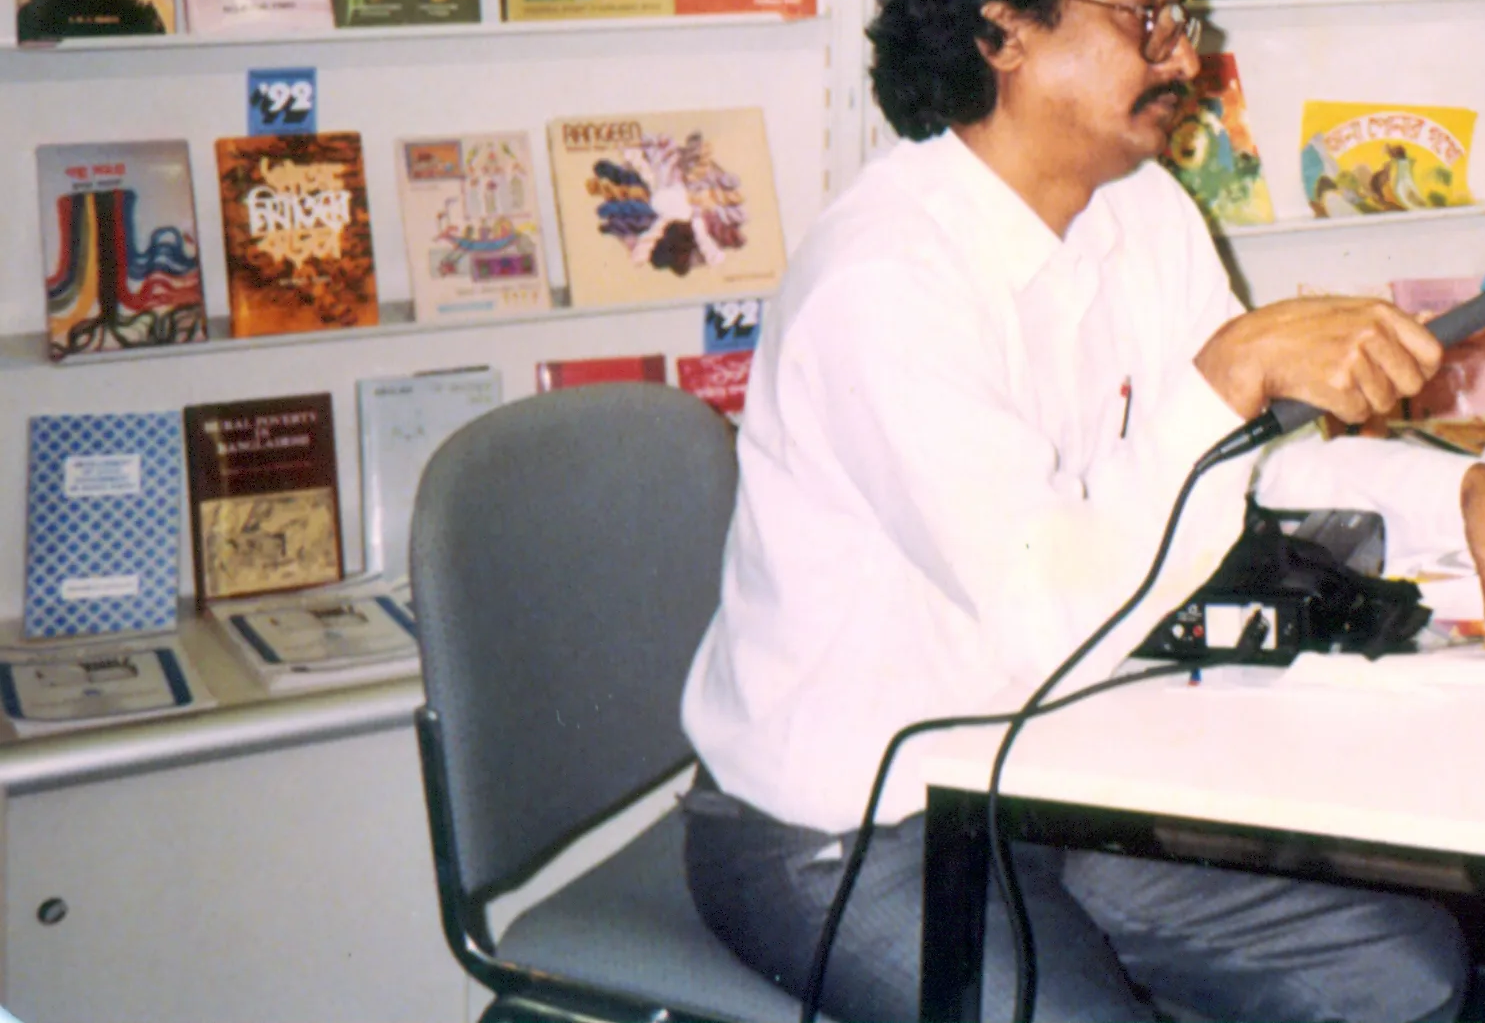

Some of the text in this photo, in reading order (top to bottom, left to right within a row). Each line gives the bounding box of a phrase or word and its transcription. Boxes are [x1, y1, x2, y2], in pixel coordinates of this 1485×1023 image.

[257, 79, 314, 117] '92
[562, 122, 643, 145] RANGEEN
[204, 411, 318, 435] RAL POVERTY
[216, 433, 311, 456] BANGLADESH
